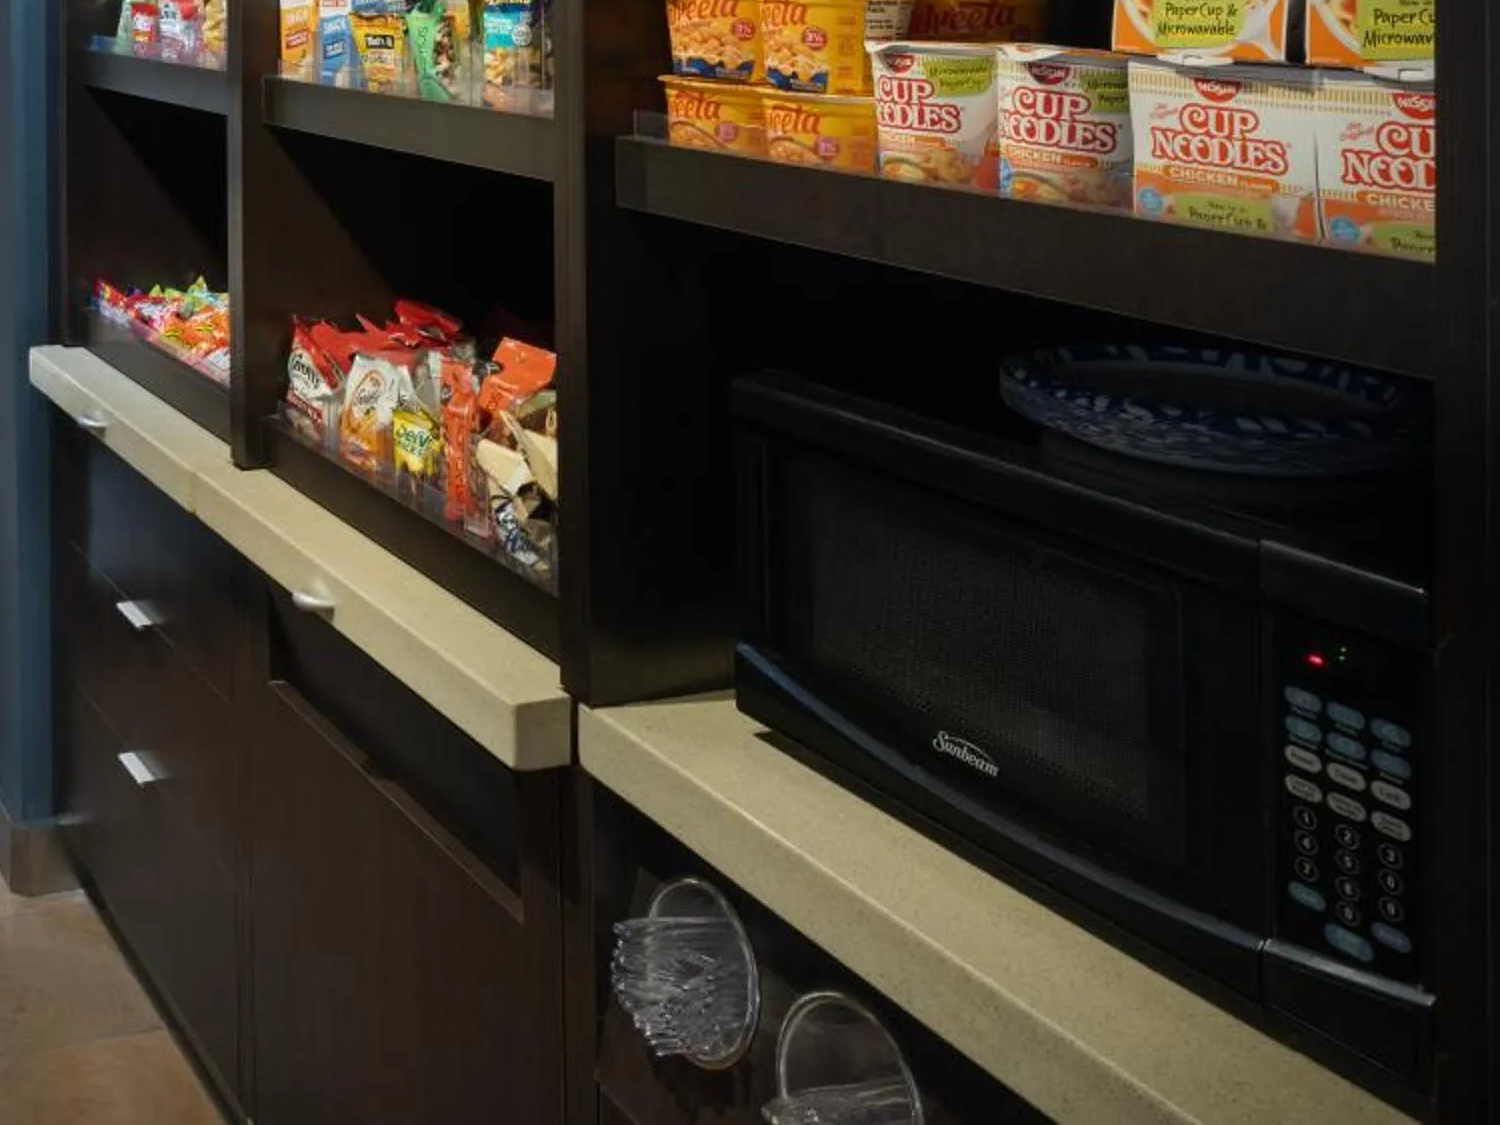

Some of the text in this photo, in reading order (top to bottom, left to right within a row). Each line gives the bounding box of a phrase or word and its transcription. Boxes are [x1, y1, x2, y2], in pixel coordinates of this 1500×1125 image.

[1165, 2, 1199, 19] Paper
[1200, 2, 1224, 20] Cup
[1373, 8, 1436, 27] Paper Cu
[1363, 28, 1434, 48] Microwav
[877, 75, 935, 105] CUP
[1012, 85, 1092, 123] CUP
[1179, 102, 1260, 139] CUP
[1151, 125, 1288, 175] NOODLES
[1376, 121, 1435, 159] CU
[1341, 148, 1435, 192] NOOD
[1367, 194, 1435, 211] CHICKE
[932, 730, 999, 777] Sunbeam
